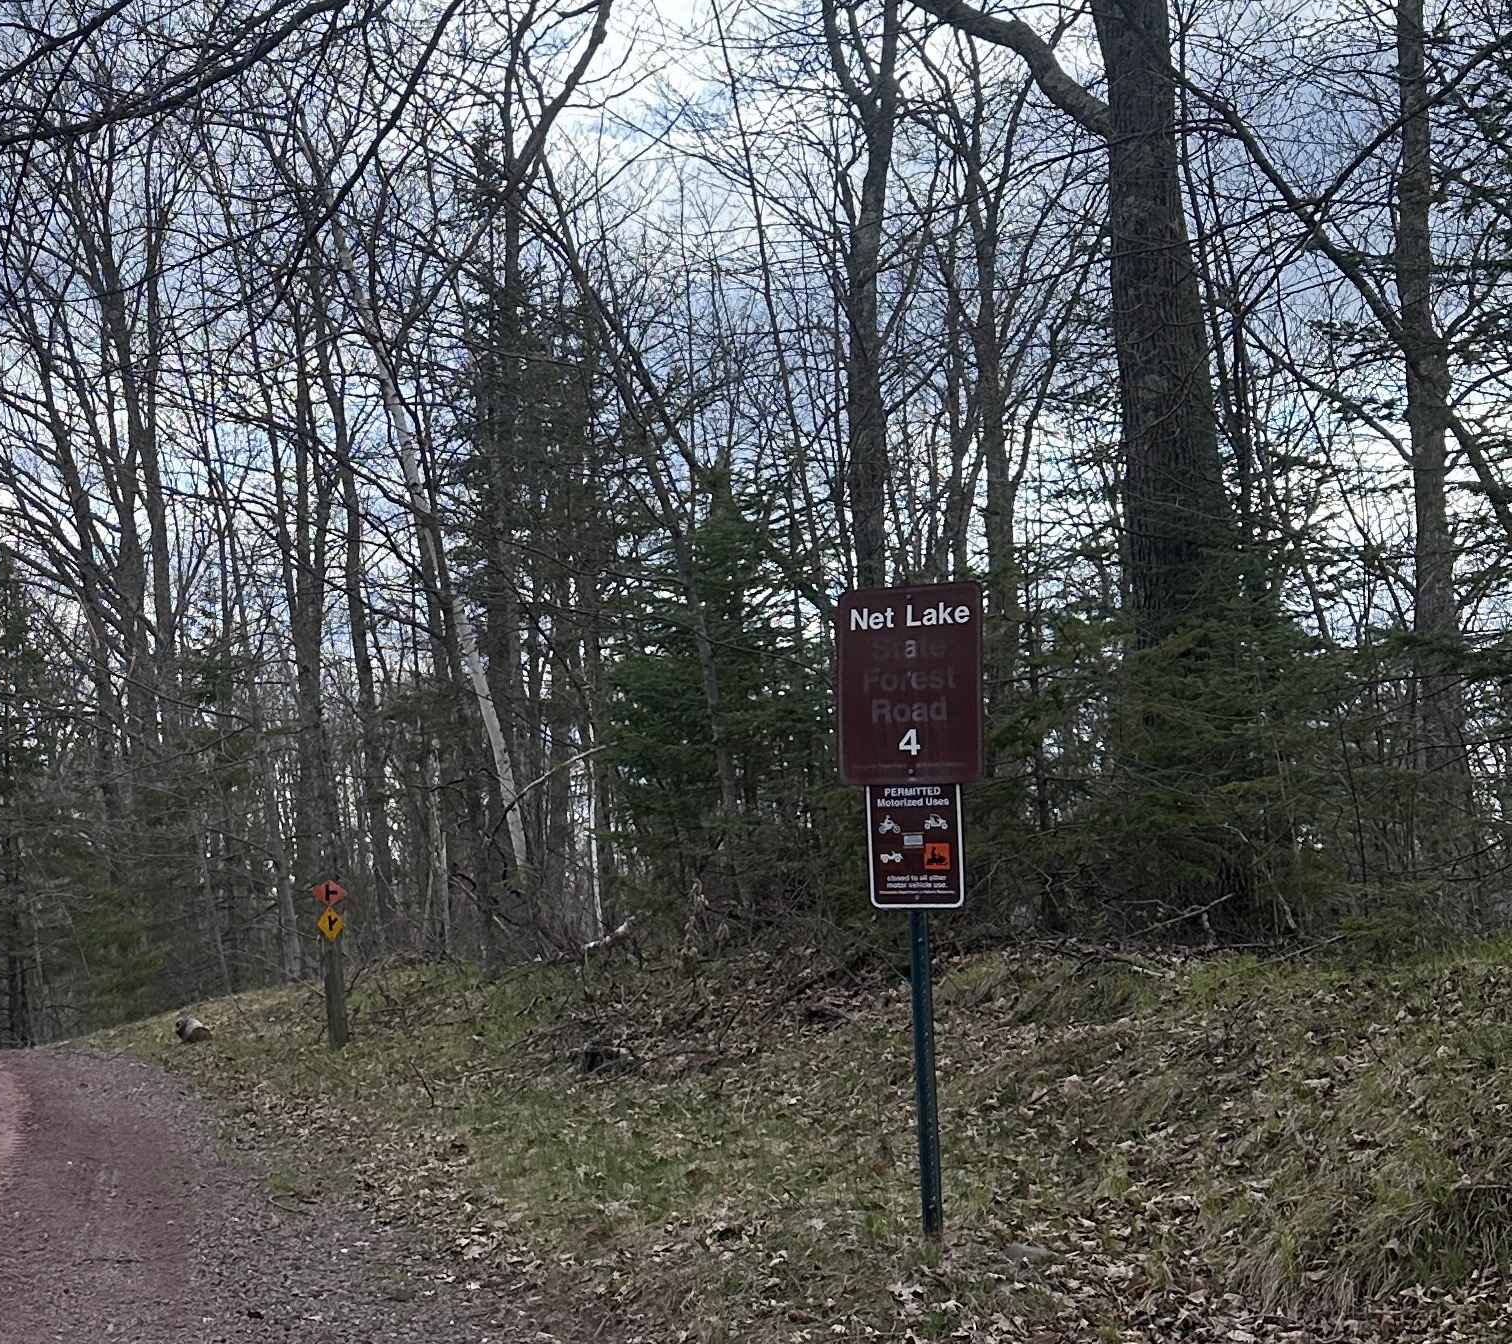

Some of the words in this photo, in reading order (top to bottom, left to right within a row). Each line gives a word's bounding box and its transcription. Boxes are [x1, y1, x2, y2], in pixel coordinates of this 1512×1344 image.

[850, 607, 895, 631] Net
[905, 601, 970, 627] Lake
[872, 636, 947, 659] State
[863, 667, 956, 693] Forest
[872, 696, 948, 723] Road
[898, 728, 921, 756] 4
[877, 798, 924, 807] Motorized
[925, 797, 949, 807] Uses
[884, 786, 941, 797] PERMITTED
